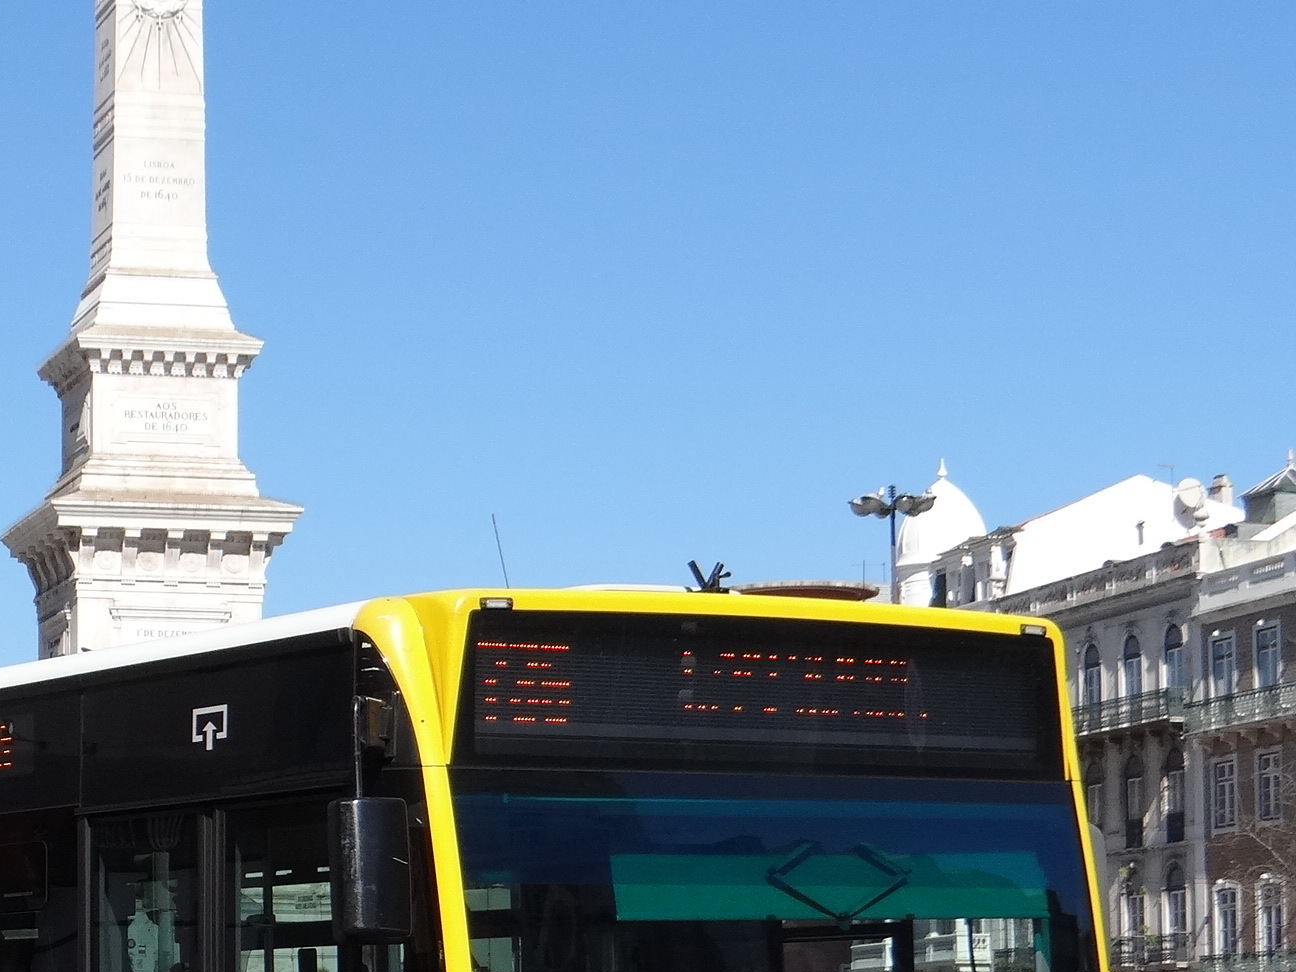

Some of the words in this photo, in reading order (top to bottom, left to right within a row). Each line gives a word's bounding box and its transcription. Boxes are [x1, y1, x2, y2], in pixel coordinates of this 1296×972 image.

[143, 160, 176, 169] LISBOA
[123, 173, 132, 183] 15
[134, 174, 145, 184] DE
[149, 175, 196, 187] DEZEMBRO
[140, 191, 151, 199] DE
[154, 189, 179, 201] 1640
[156, 402, 177, 411] AOS
[124, 409, 209, 421] RESTAURADORES
[144, 422, 158, 431] DE
[162, 421, 188, 433] 1640
